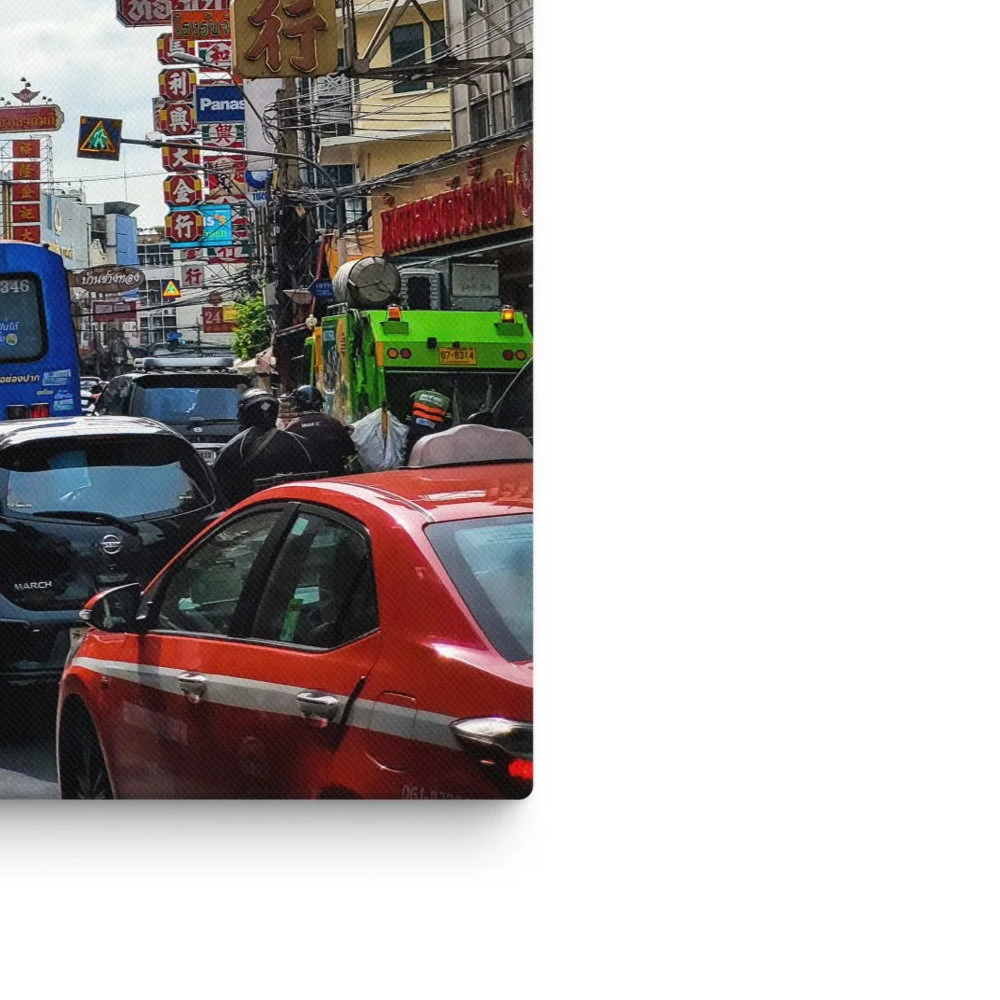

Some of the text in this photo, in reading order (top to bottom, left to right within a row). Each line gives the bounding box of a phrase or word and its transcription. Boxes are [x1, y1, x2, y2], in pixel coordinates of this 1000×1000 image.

[173, 12, 230, 36] โรงรับจ
[204, 311, 222, 324] 24
[13, 580, 53, 591] MARCH
